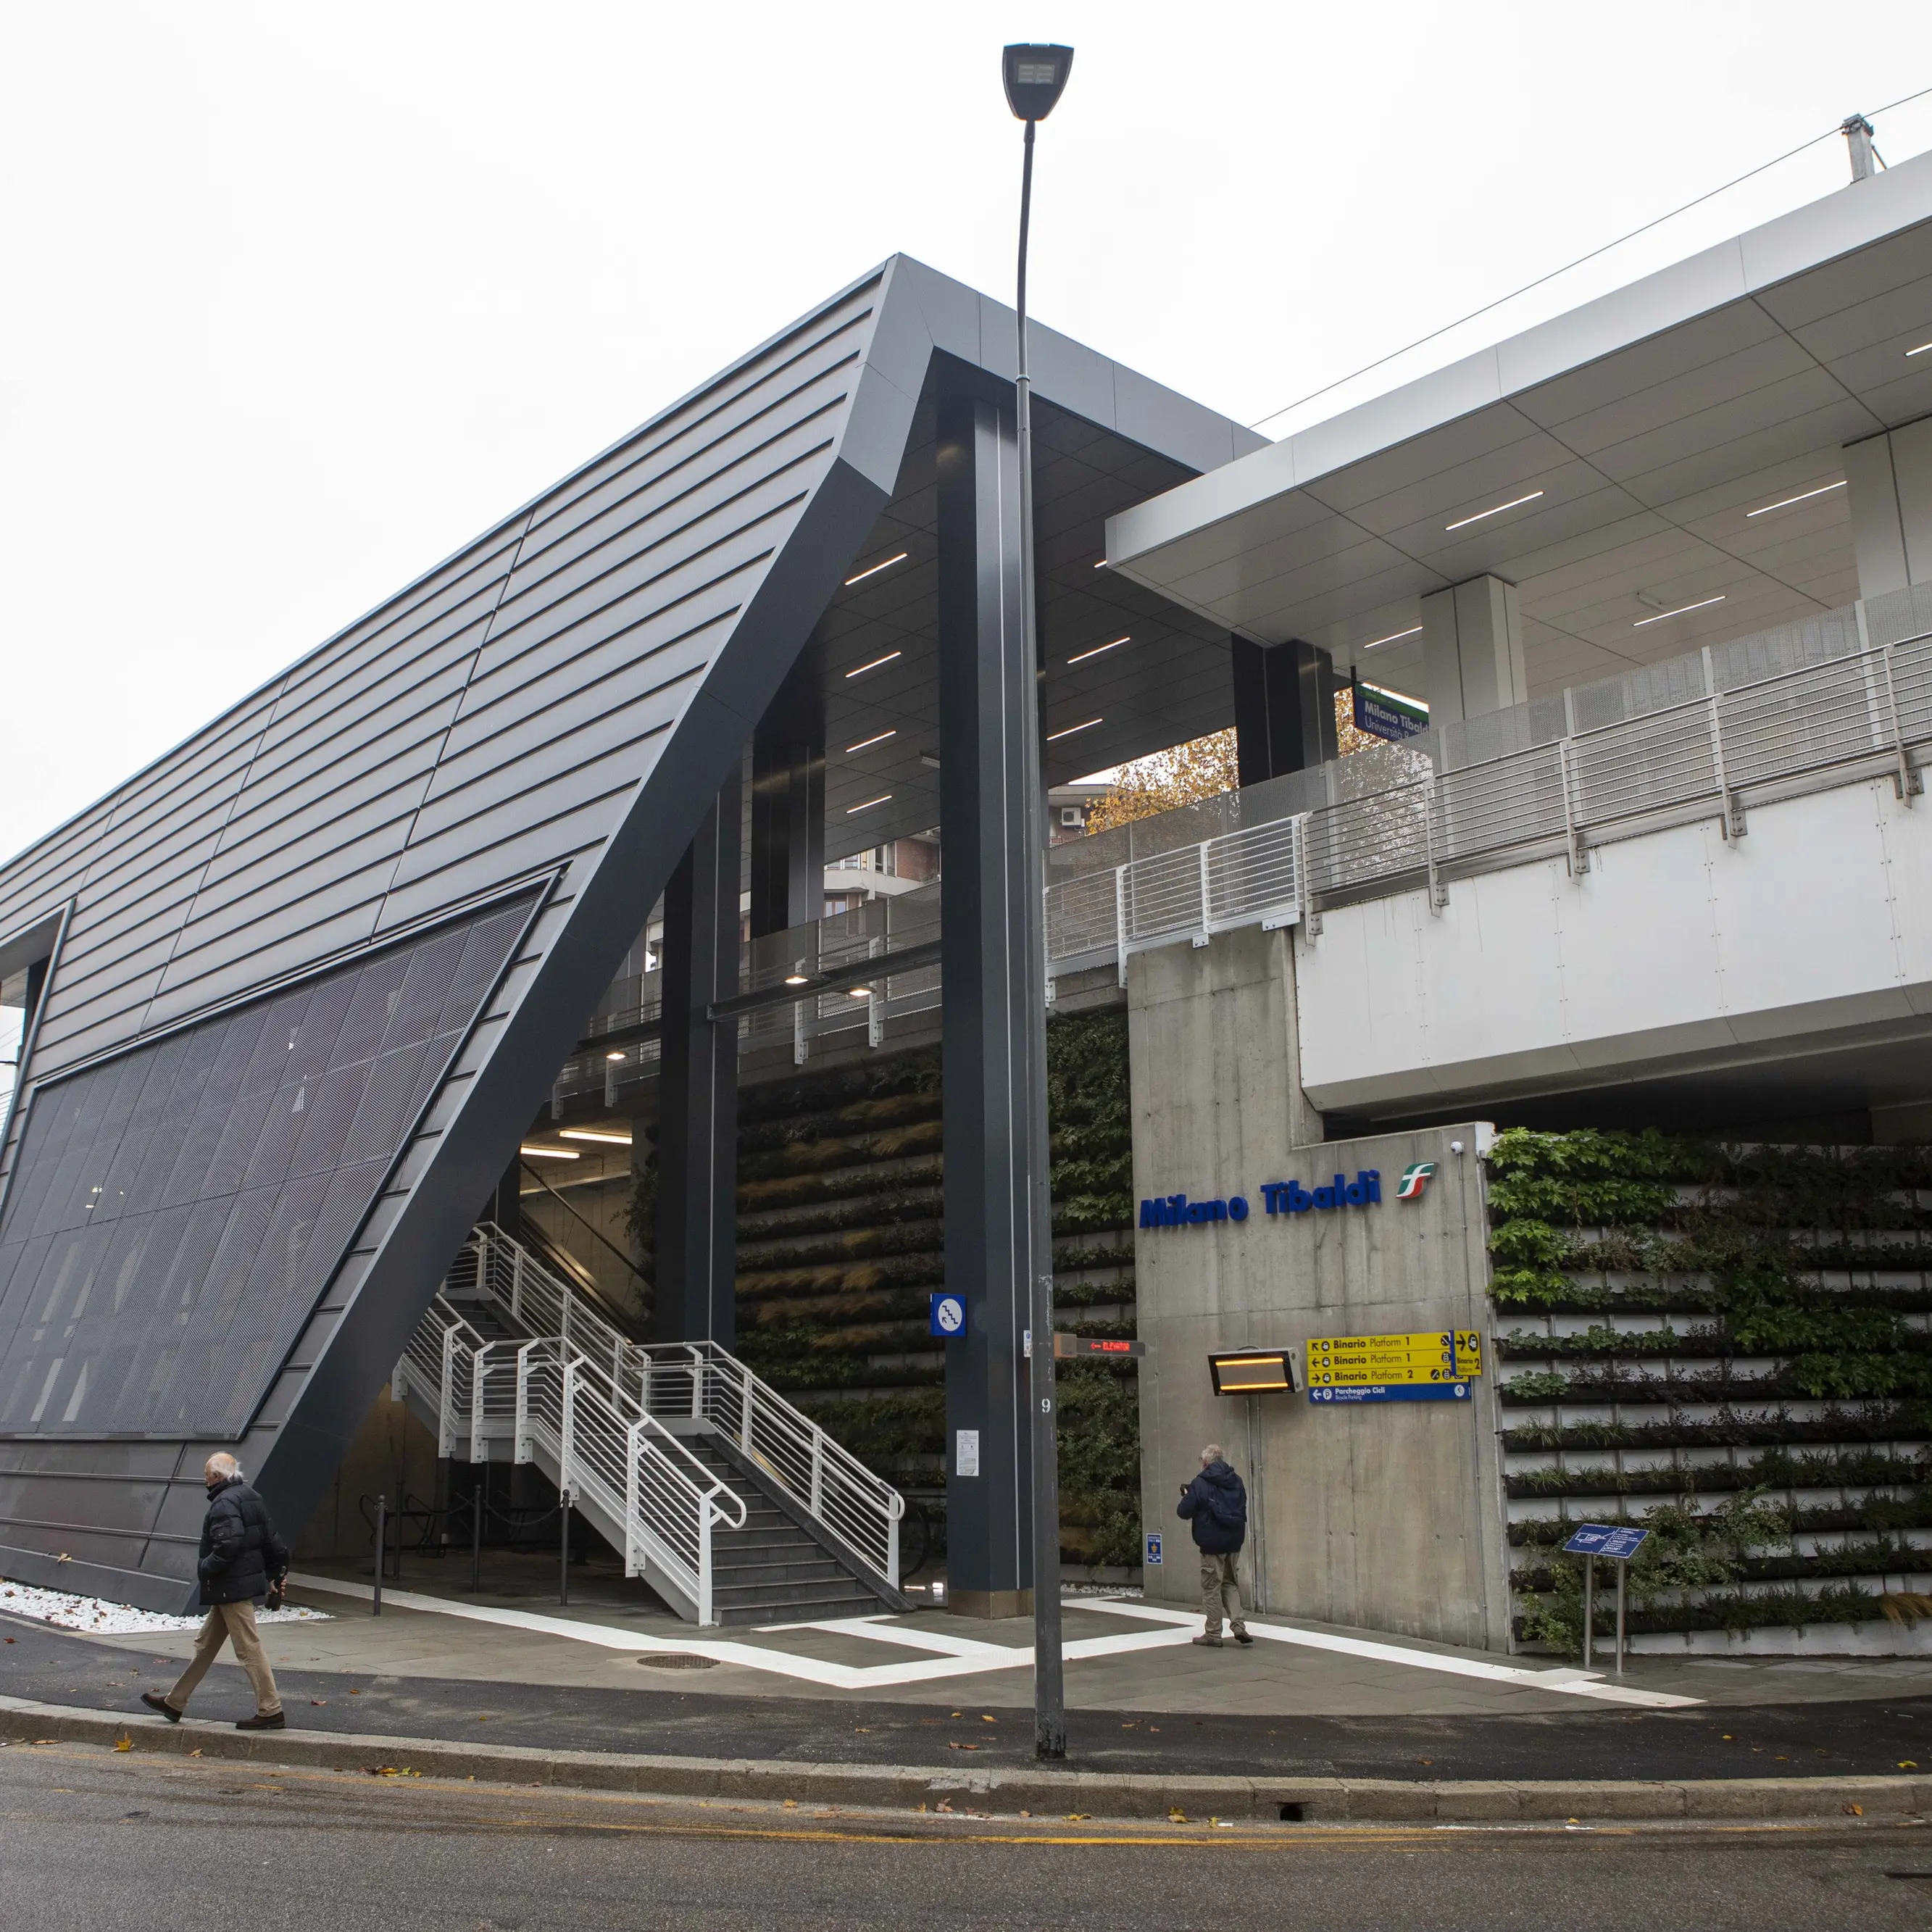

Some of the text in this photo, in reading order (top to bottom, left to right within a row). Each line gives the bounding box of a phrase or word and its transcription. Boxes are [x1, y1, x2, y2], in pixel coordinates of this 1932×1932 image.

[1365, 701, 1428, 733] Milano Tibald
[1139, 1169, 1381, 1228] Milano Tibaldi
[1102, 1342, 1131, 1352] ELEVATOR
[1333, 1336, 1410, 1349] Binario Platform 1
[1334, 1353, 1410, 1365] Binario Platform 1
[1474, 1357, 1480, 1370] 2
[1335, 1370, 1413, 1381] Binario Platform 2
[1335, 1387, 1371, 1396] Parcheggio
[1041, 1398, 1051, 1413] 9
